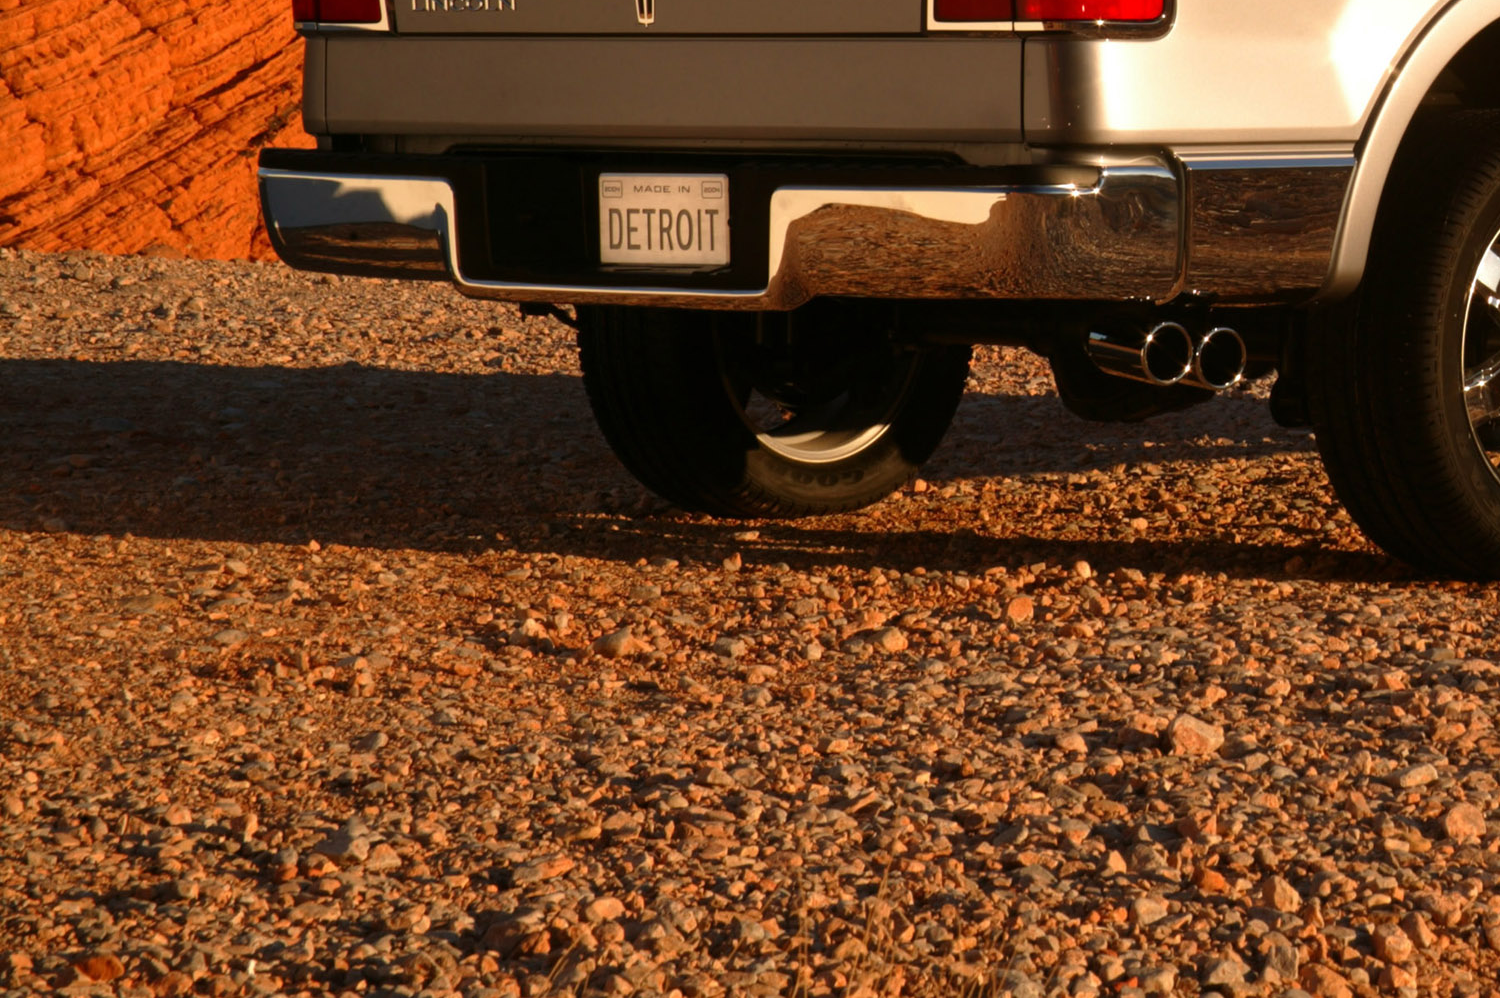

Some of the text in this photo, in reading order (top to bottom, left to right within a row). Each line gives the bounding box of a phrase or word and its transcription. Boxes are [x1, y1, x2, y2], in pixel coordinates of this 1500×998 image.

[633, 185, 691, 193] MADE IN
[608, 208, 719, 251] DETROIT
